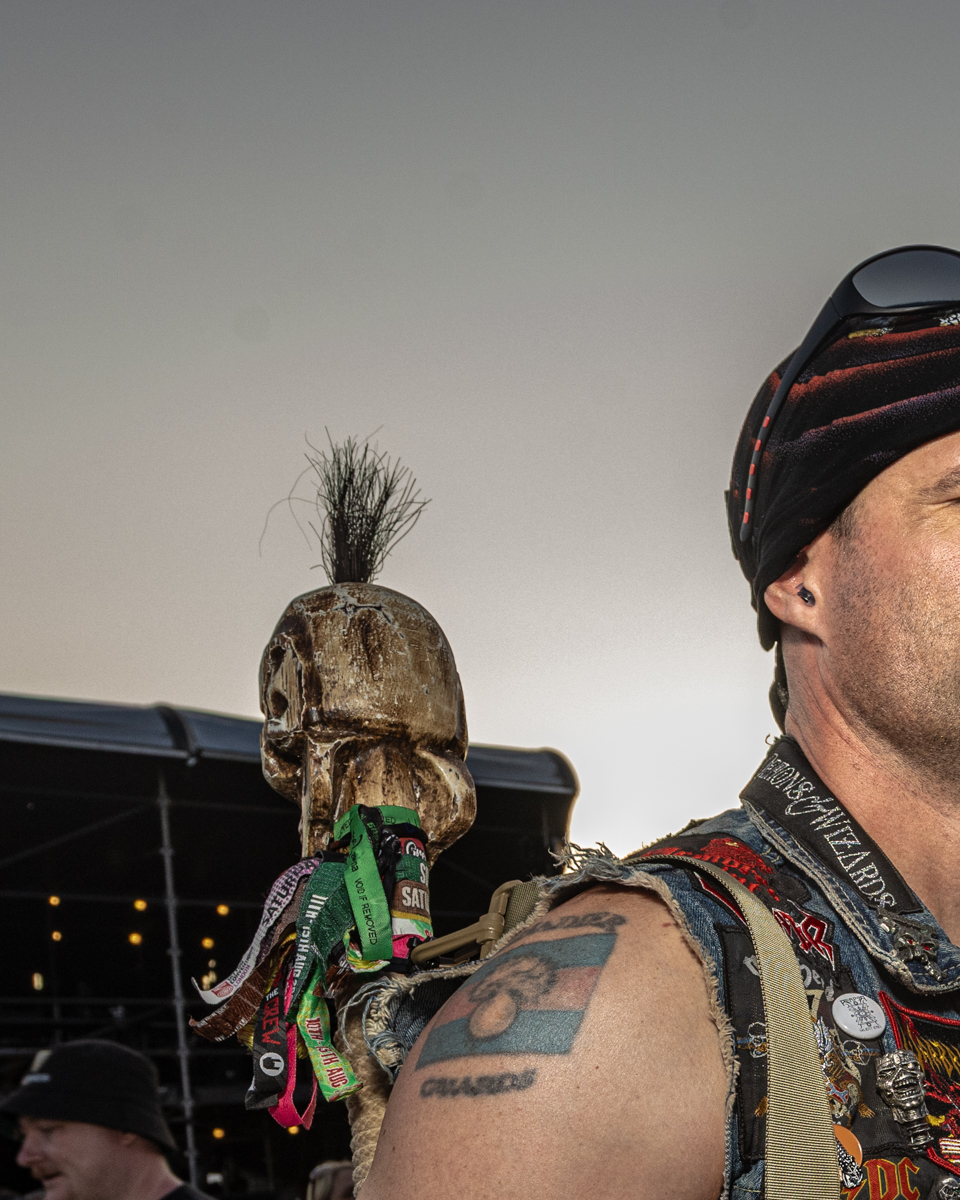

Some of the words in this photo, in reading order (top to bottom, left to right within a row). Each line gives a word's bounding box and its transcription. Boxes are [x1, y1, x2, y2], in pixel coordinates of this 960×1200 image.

[809, 806, 897, 908] WIZARDS
[260, 860, 316, 927] SATURDA
[401, 887, 430, 914] SATU
[361, 903, 377, 946] REMOVED
[233, 964, 250, 987] LONDON
[266, 988, 279, 1001] THE
[262, 997, 280, 1045] CREW
[305, 1017, 324, 1041] 10TH
[326, 1067, 349, 1088] AUG
